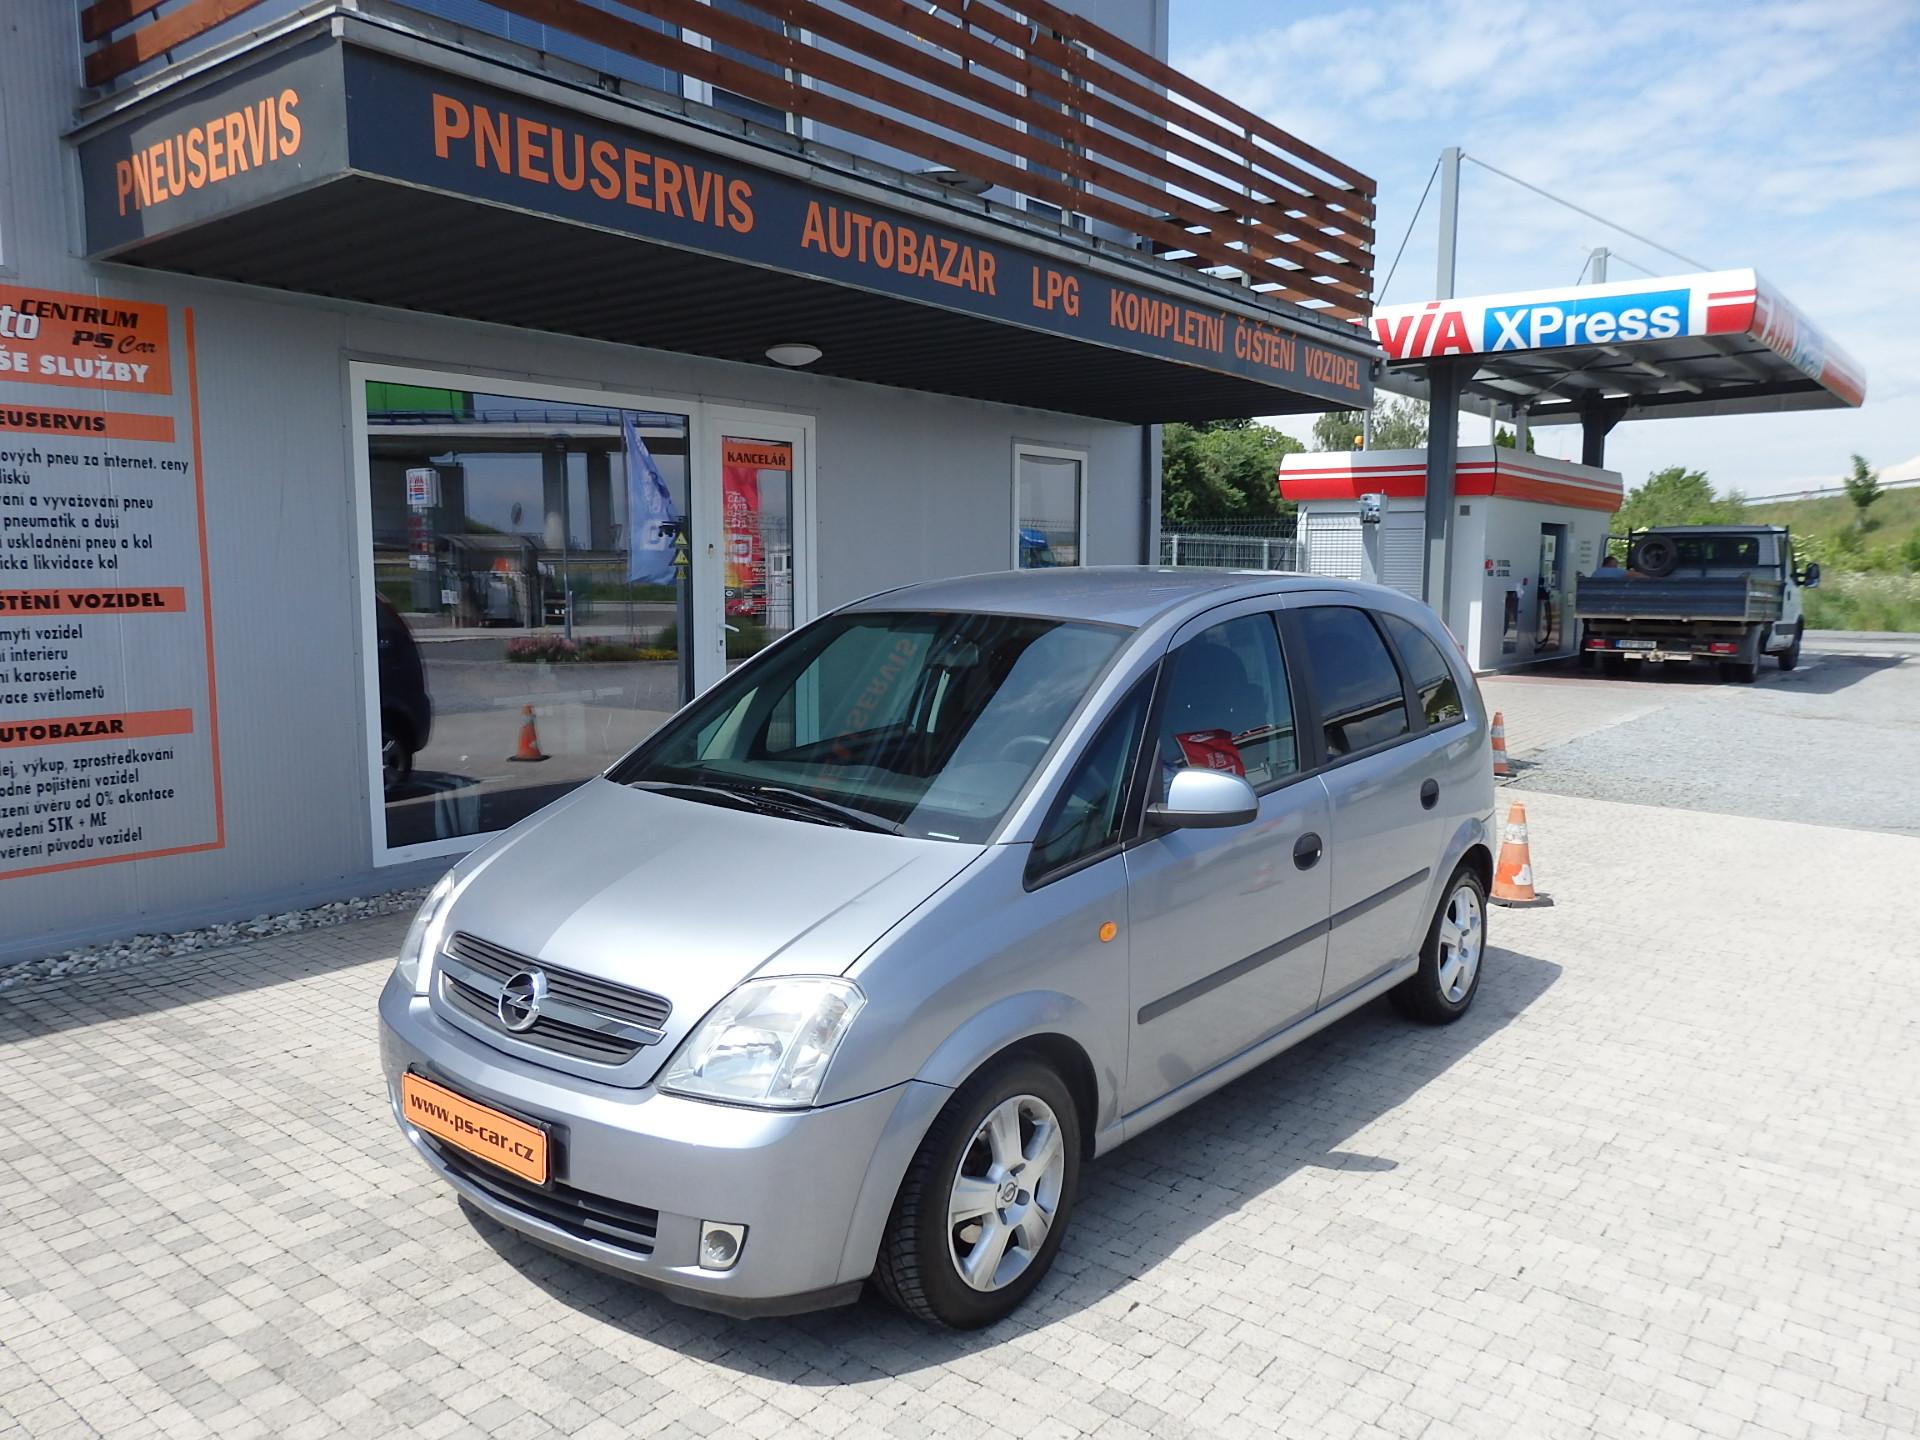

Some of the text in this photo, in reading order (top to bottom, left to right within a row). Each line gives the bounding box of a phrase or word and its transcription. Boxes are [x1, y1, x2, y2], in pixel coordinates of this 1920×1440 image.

[116, 88, 301, 217] PNEUSERVIS
[432, 92, 1360, 391] PNEUSERVIS AUTOBAZAR LPG KOMPLETNÍ ČIŠTĚNÍ VOZIDEL
[20, 299, 138, 329] CENTRUM
[1492, 304, 1680, 352] XPress
[72, 330, 156, 354] PS Car
[39, 354, 149, 383] SLUŽBY
[47, 453, 79, 467] pneu
[84, 455, 99, 466] za
[161, 459, 189, 474] ceny
[727, 451, 786, 466] KANCELÁŘ
[29, 496, 38, 506] a
[43, 494, 119, 510] vyvažování
[124, 497, 153, 512] pneu
[4, 512, 77, 531] pneumatik
[81, 517, 89, 528] a
[7, 533, 81, 549] uskladnění
[86, 537, 117, 552] pneu
[121, 538, 129, 548] a
[133, 534, 153, 549] kol
[33, 555, 94, 570] likvidace
[99, 554, 118, 569] kol
[67, 592, 165, 609] VOZIDEL
[35, 624, 83, 640] vozidel
[10, 646, 68, 662] interiéru
[14, 666, 77, 682] karoserie
[33, 685, 105, 703] světlometů
[73, 746, 174, 772] zprostředkování
[36, 774, 90, 798] pojištění
[95, 768, 139, 786] vozidel
[34, 799, 71, 815] úvěru
[76, 793, 91, 809] od
[95, 791, 114, 807] 0%
[118, 788, 175, 804] akontace
[48, 816, 74, 833] STK
[79, 817, 85, 827] +
[90, 811, 108, 828] ME
[47, 834, 94, 857] původu
[98, 826, 142, 846] vozidel
[410, 1093, 535, 1162] www.ps-car.cz
